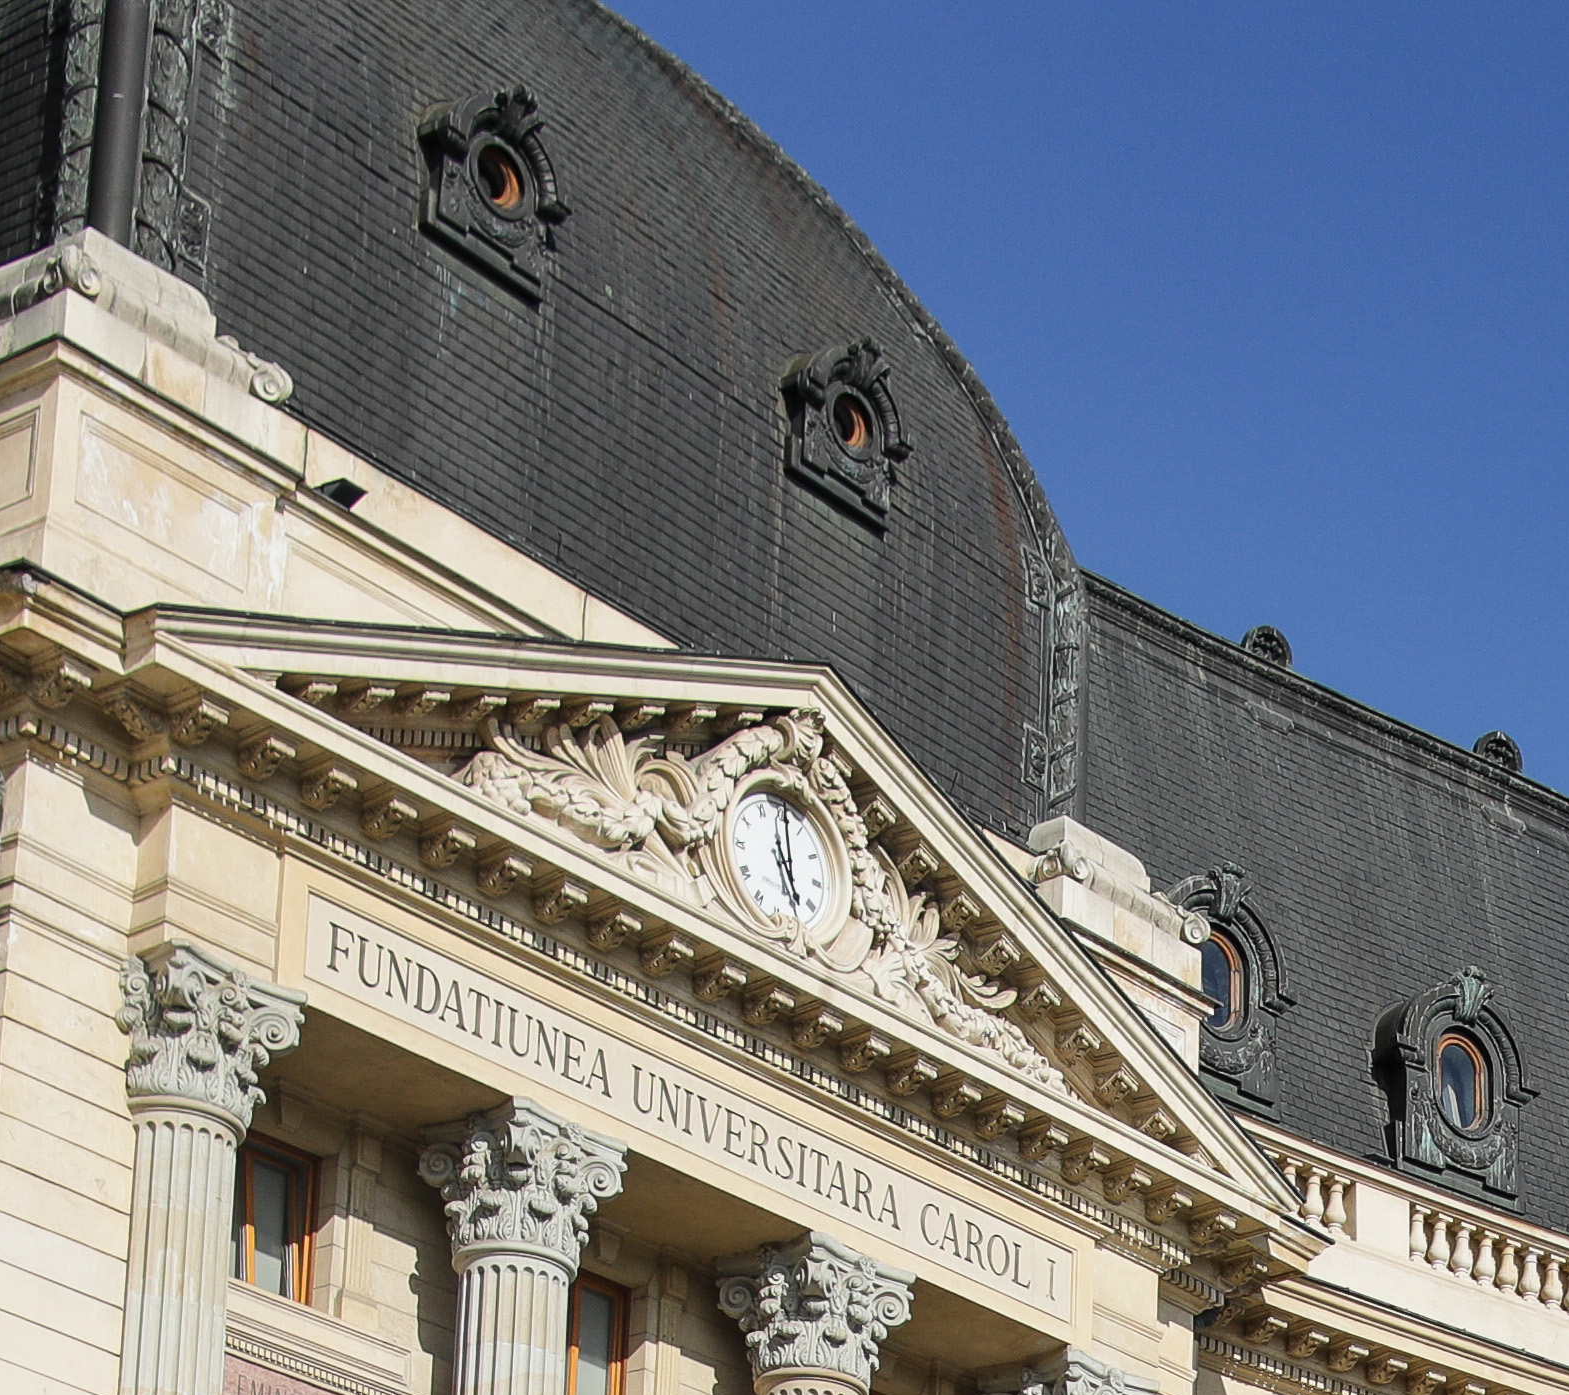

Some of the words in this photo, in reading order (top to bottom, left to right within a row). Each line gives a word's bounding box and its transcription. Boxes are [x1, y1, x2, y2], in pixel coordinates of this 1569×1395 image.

[326, 920, 611, 1099] FUNDATIUNEA
[632, 1064, 901, 1231] UNIVERSITARA
[921, 1201, 1032, 1291] CAROL
[1045, 1256, 1059, 1302] I
